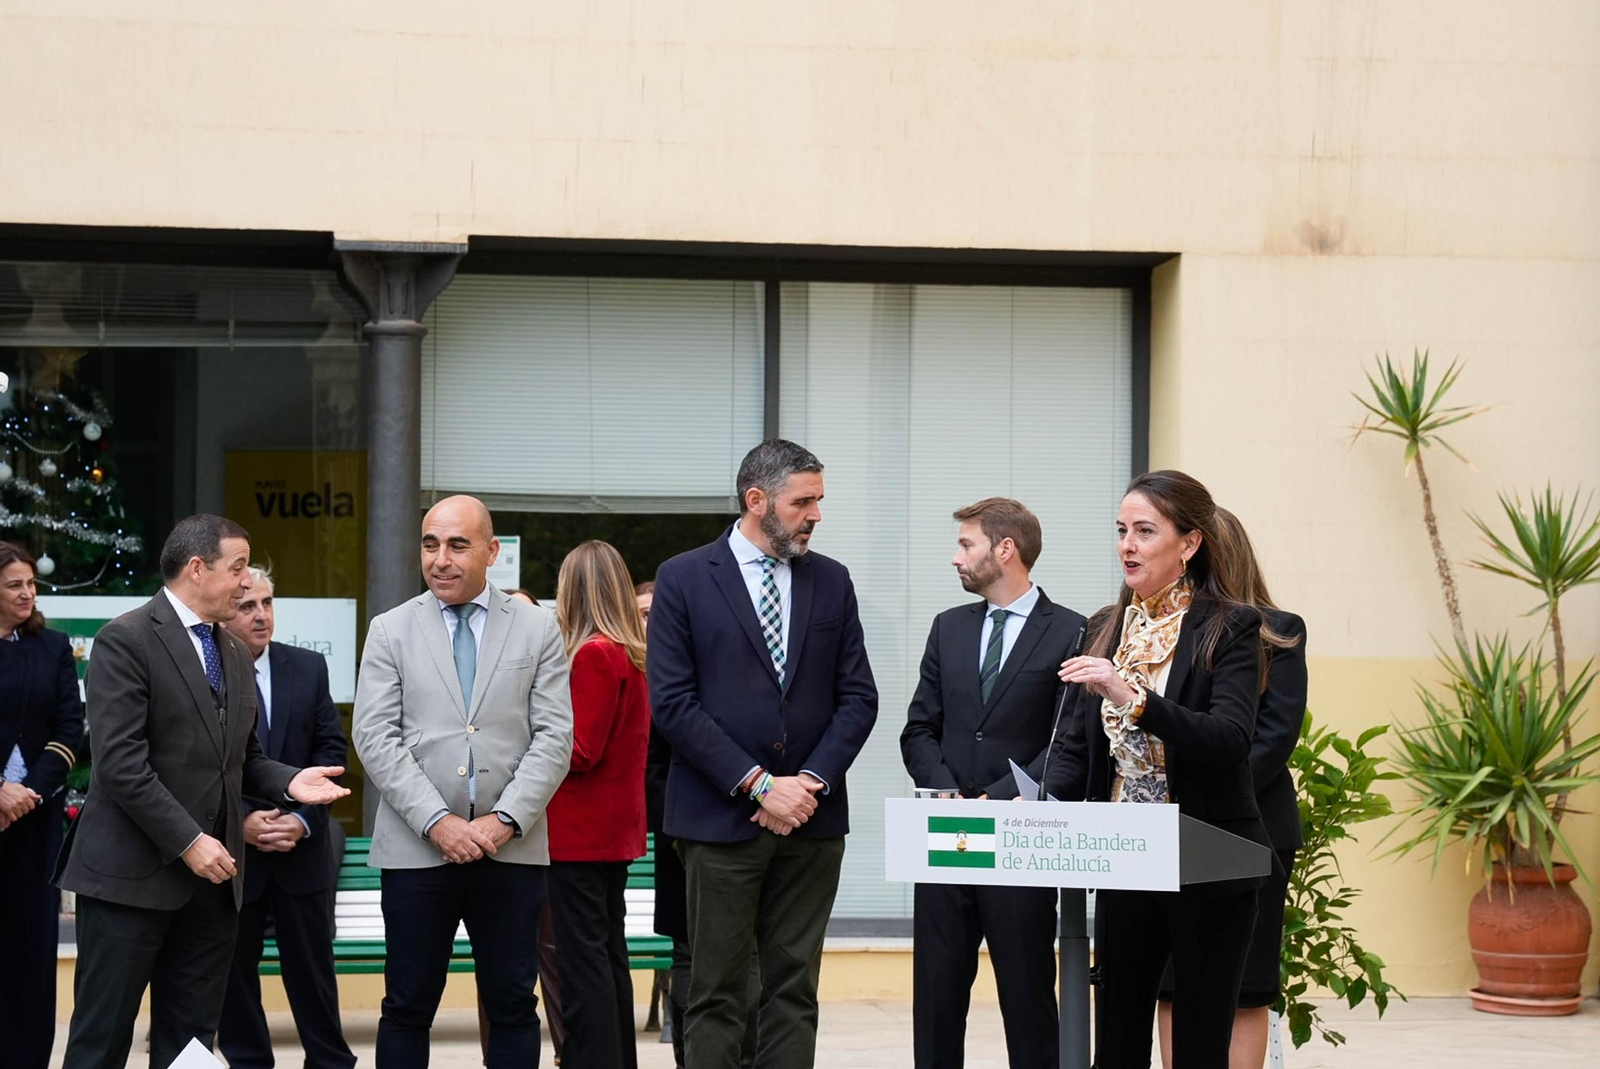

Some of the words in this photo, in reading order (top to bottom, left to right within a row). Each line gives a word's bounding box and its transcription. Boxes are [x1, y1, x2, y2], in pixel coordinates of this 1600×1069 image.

[255, 482, 354, 518] vuela
[1003, 818, 1009, 827] 4
[1011, 817, 1022, 827] de
[1024, 818, 1069, 829] Diciembre
[1002, 831, 1029, 849] Día
[1033, 831, 1055, 849] de
[1058, 831, 1073, 850] la
[1077, 833, 1147, 852] Bandera
[1002, 852, 1023, 870] de
[1026, 853, 1112, 873] Andalucía
